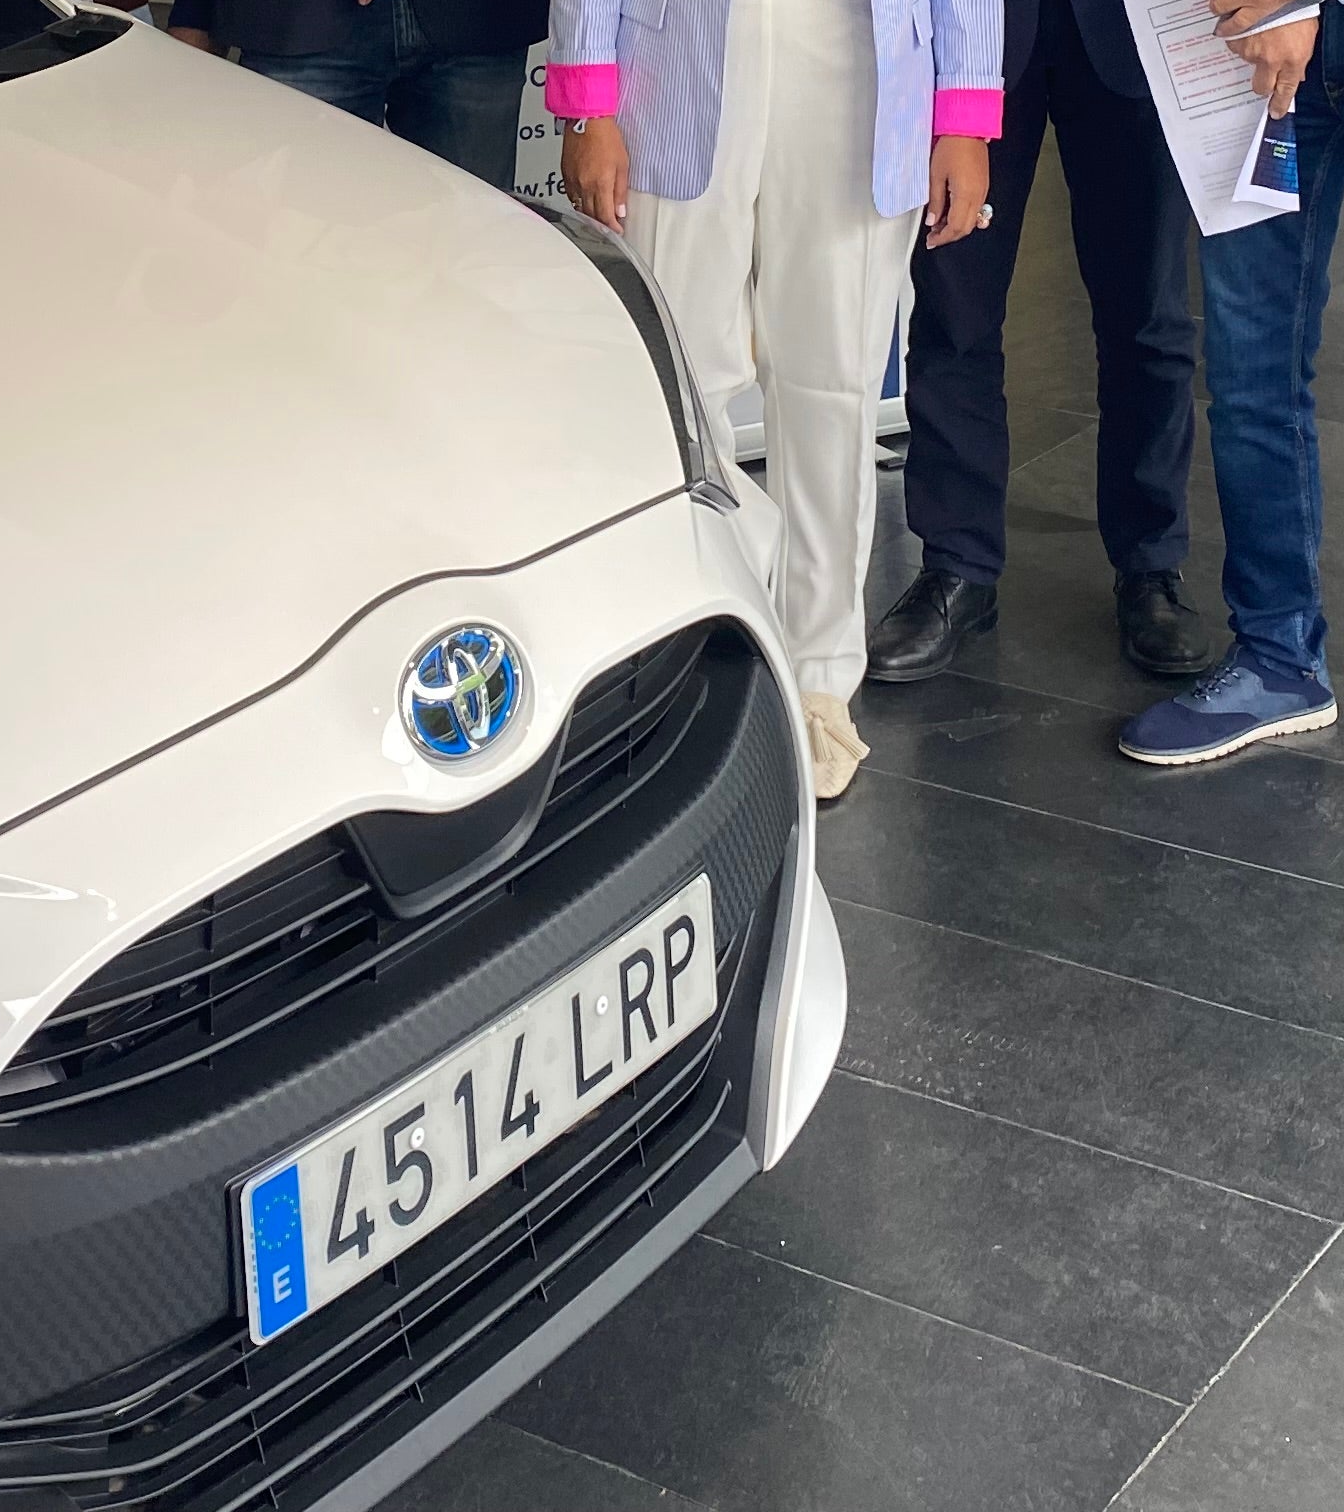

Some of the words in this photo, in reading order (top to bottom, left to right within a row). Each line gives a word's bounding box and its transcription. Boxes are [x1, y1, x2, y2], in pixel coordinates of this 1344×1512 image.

[327, 1031, 541, 1265] 4514
[571, 914, 696, 1100] LRP
[272, 1264, 293, 1304] E
